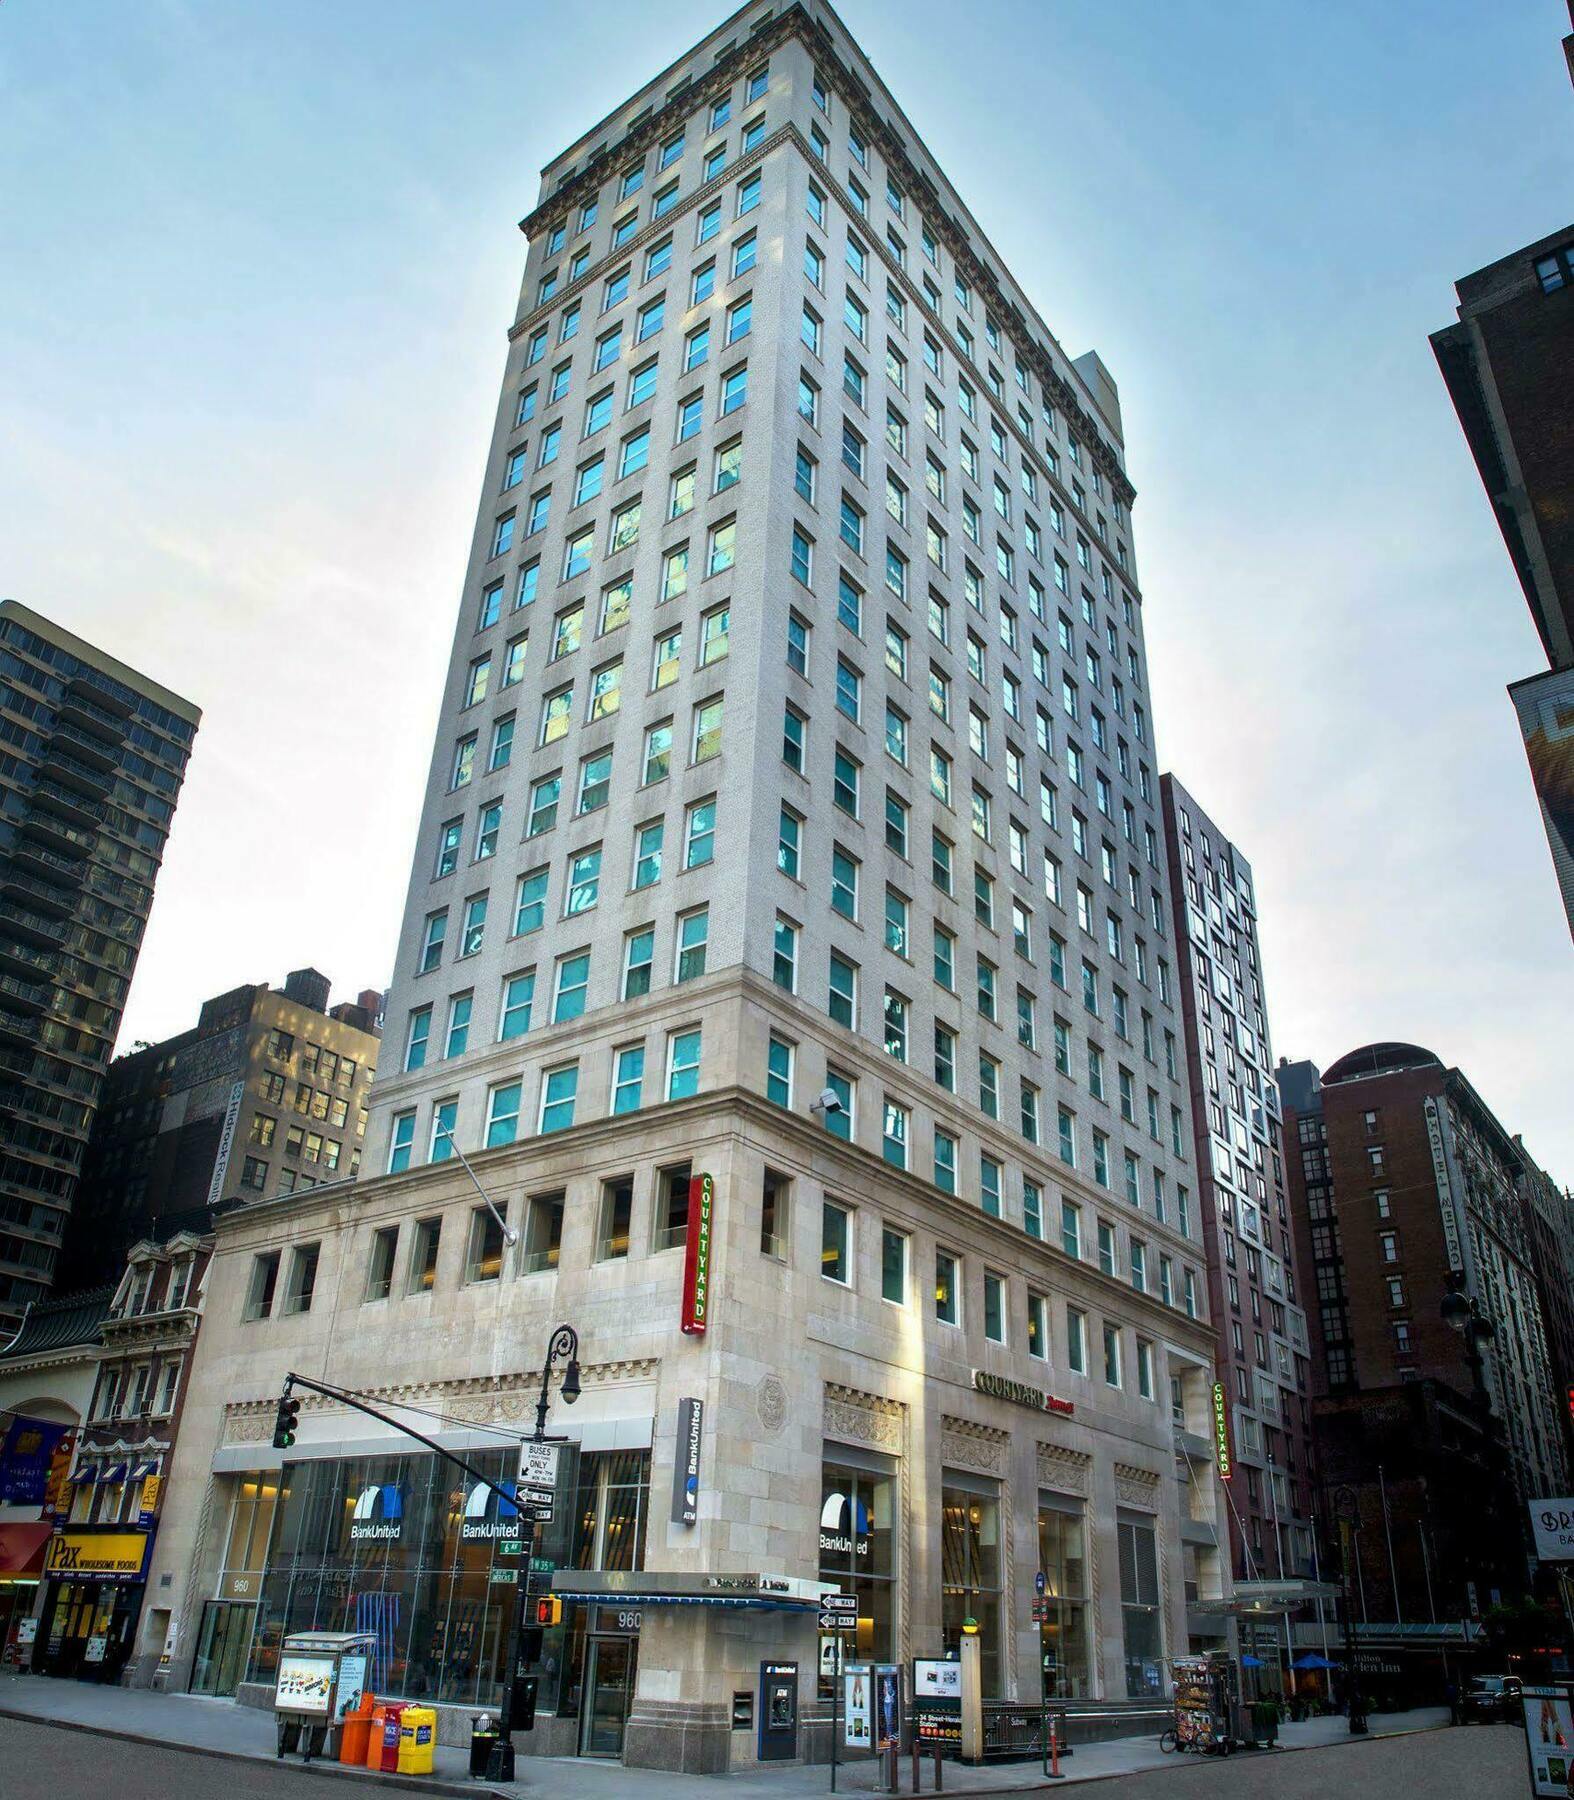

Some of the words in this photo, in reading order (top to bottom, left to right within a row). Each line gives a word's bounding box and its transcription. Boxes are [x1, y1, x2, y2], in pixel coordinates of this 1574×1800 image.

[219, 1101, 239, 1160] Hidrock
[1428, 1120, 1448, 1187] HOTEL
[1440, 1197, 1460, 1265] METRO
[695, 1177, 711, 1317] COURTYARD
[975, 1370, 1046, 1408] COURTYARD
[1214, 1383, 1229, 1472] COURTYARD
[688, 1401, 701, 1475] BankUnited
[529, 1445, 551, 1456] BUSES
[529, 1459, 547, 1470] ONLY
[142, 1481, 159, 1507] Pax
[521, 1491, 534, 1499] ONE
[537, 1510, 549, 1518] WAY
[683, 1511, 696, 1520] ATM
[1541, 1511, 1574, 1532] BR
[351, 1523, 401, 1539] BankUnited
[463, 1522, 519, 1538] BankUnited
[504, 1543, 509, 1553] 6
[819, 1533, 868, 1555] BankUned
[51, 1537, 82, 1569] Pax
[79, 1559, 115, 1570] WHOLESOME
[116, 1561, 138, 1570] FOODS
[234, 1580, 249, 1592] 960
[824, 1598, 836, 1607] ONE
[841, 1598, 855, 1607] WAY
[618, 1611, 641, 1628] 960
[823, 1616, 836, 1625] ONE
[838, 1616, 853, 1625] WAY
